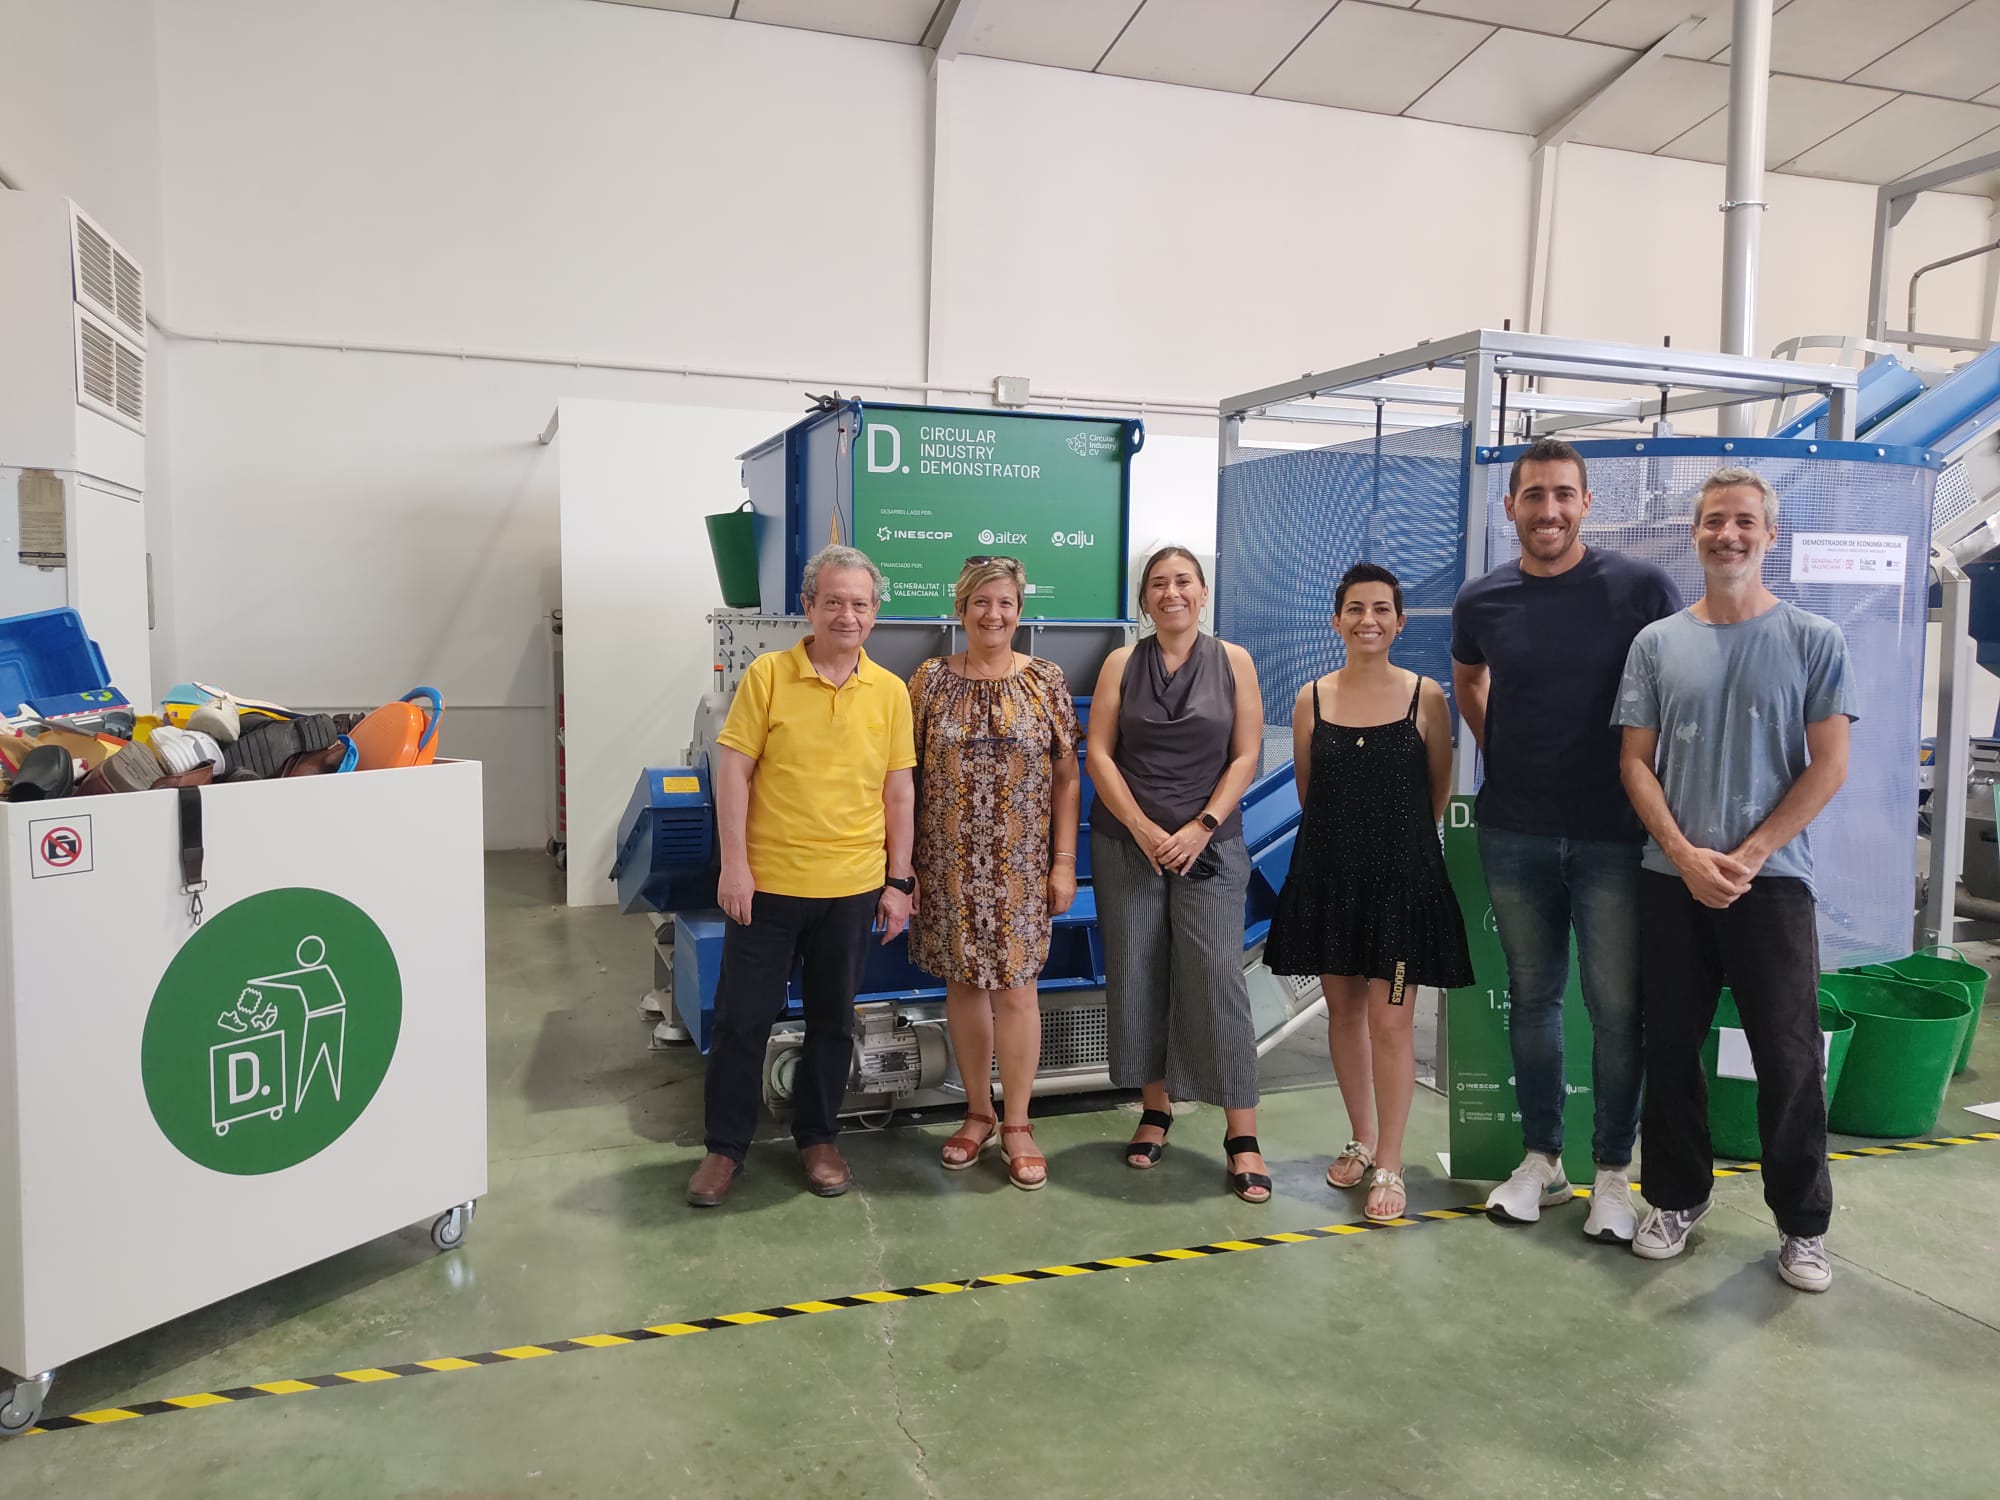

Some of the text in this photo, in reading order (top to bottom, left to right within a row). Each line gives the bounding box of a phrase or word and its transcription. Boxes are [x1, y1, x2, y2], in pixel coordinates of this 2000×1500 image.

[920, 426, 996, 444] CIRCULAR
[1089, 434, 1116, 442] Circular
[867, 423, 910, 474] D.
[920, 443, 995, 460] INDUSTRY
[1089, 441, 1117, 451] Industry
[1089, 448, 1100, 456] CV
[920, 460, 1041, 479] DEMONSTRATOR
[894, 530, 953, 540] INESCOP
[995, 531, 1028, 545] aitex
[1066, 530, 1094, 549] aiju
[893, 582, 940, 590] GENERALITAT
[1450, 802, 1476, 828] D.
[228, 1051, 271, 1104] D.
